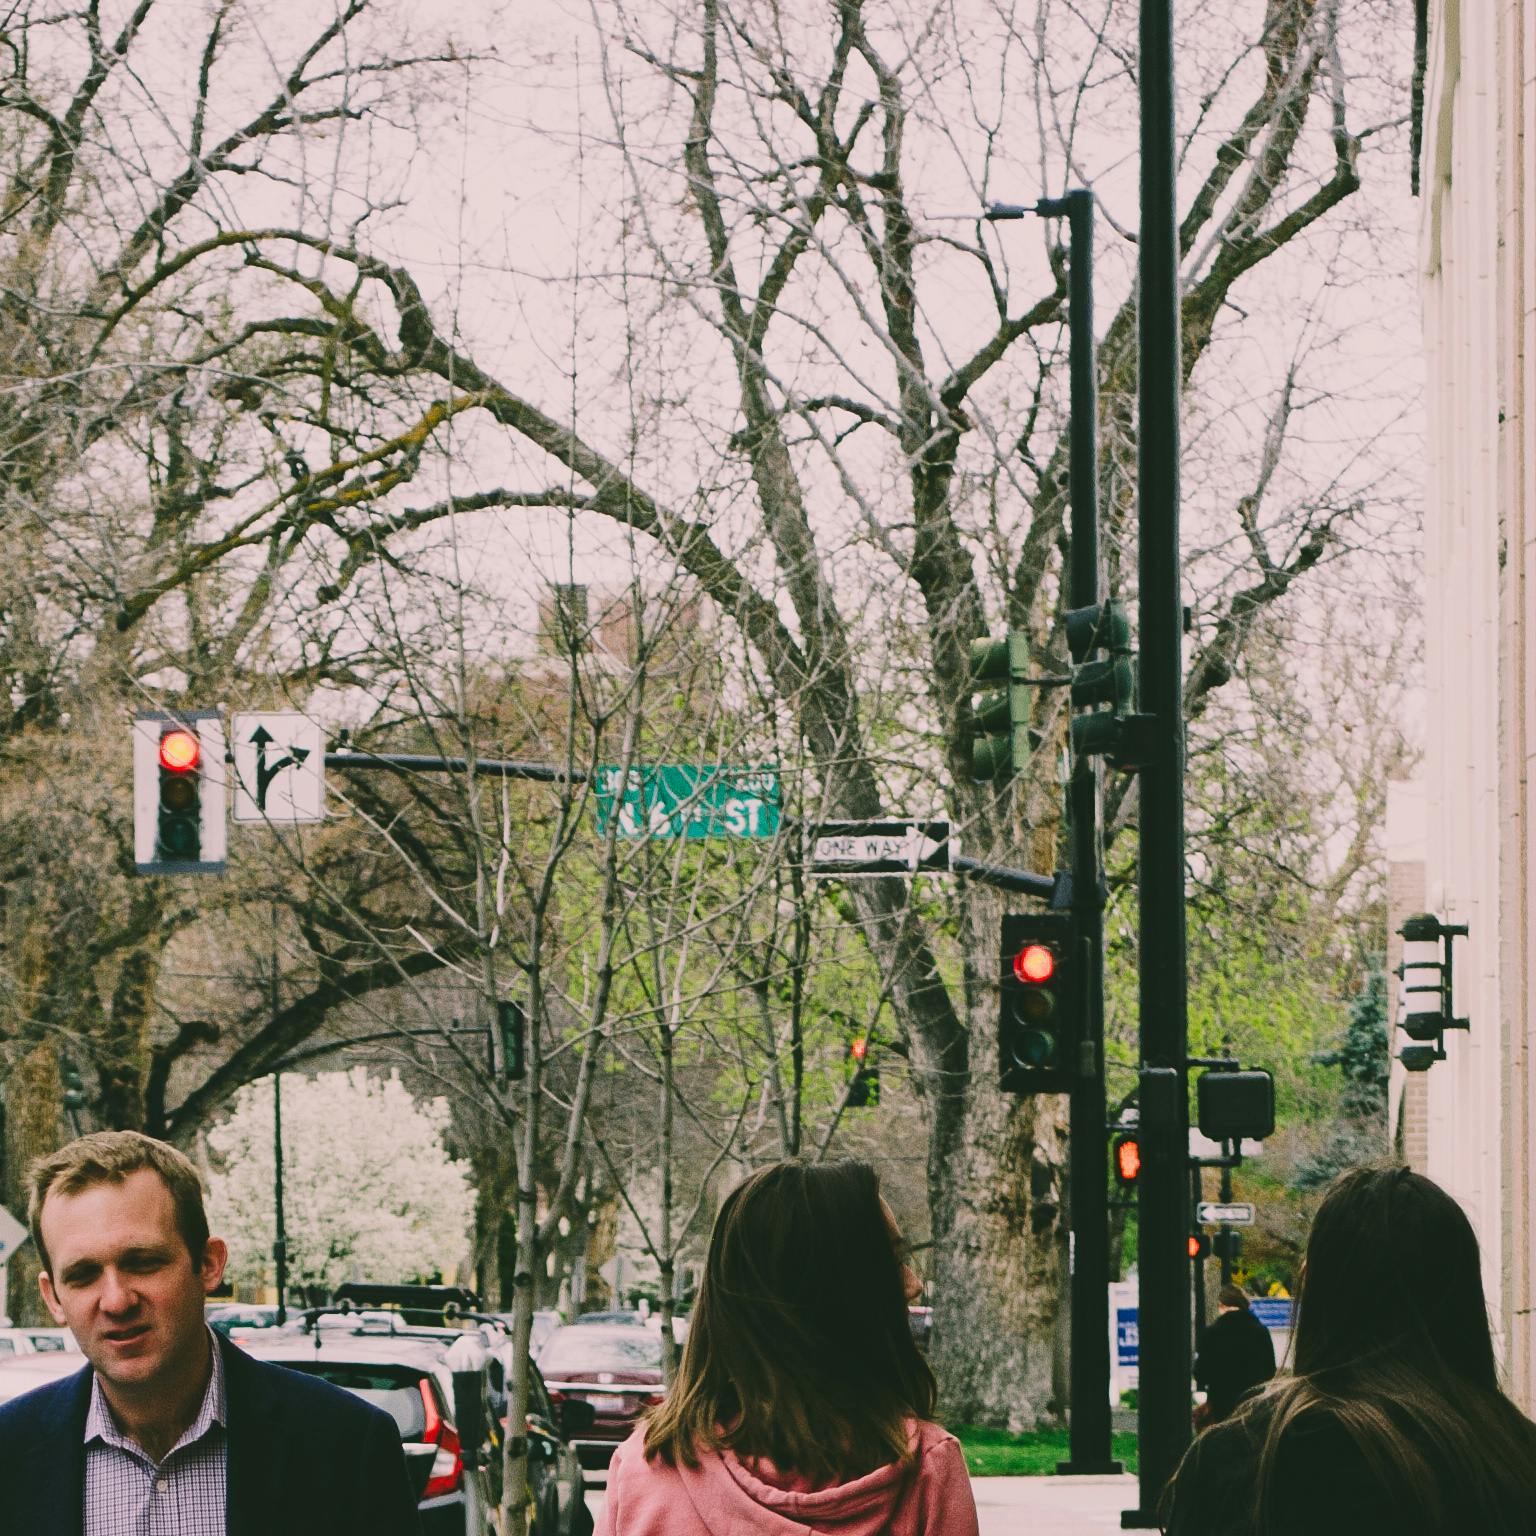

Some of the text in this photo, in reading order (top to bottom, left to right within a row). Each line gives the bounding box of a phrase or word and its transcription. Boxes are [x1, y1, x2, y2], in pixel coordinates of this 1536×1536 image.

[725, 800, 763, 835] ST
[820, 840, 904, 857] ONE WAY
